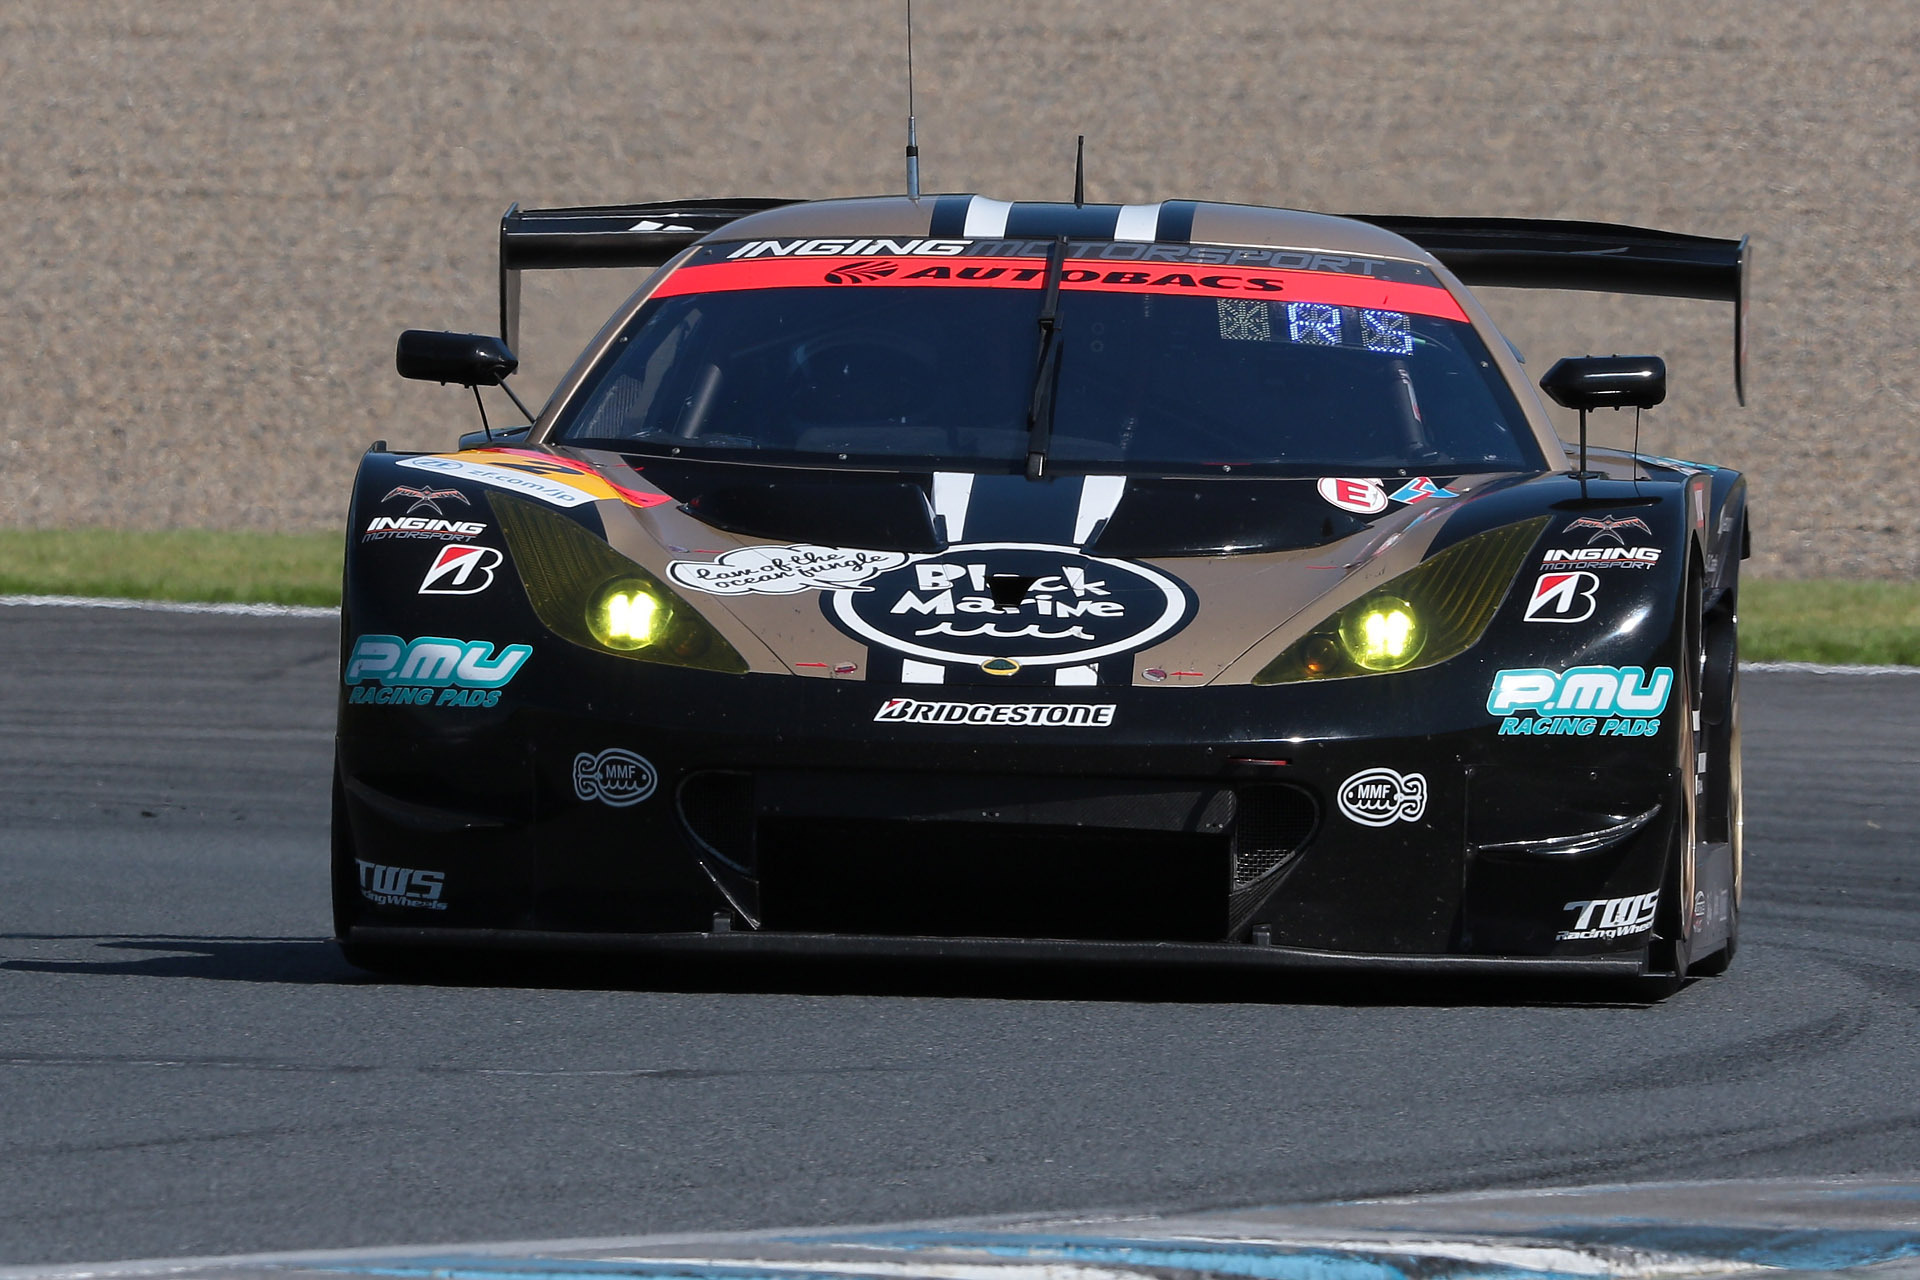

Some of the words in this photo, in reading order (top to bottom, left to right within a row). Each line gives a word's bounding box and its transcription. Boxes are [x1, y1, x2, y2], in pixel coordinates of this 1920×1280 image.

[726, 239, 974, 260] INGING
[971, 240, 1386, 275] MOTORSPORT
[900, 266, 1284, 291] AUTOBACS
[367, 516, 487, 535] INGING
[362, 530, 477, 543] MOTORSPORT
[1543, 547, 1661, 561] INGING
[1539, 560, 1656, 570] MOTORSPORT
[915, 563, 1112, 597] Blck
[350, 686, 434, 706] RACING
[436, 688, 502, 708] PADS
[876, 699, 1115, 725] BRIDGESTONE
[1498, 717, 1597, 736] RACING
[1600, 718, 1660, 736] PADS
[606, 765, 636, 778] MMF
[1357, 784, 1390, 799] MMF
[355, 858, 445, 899] TWS
[1563, 888, 1660, 930] TWS
